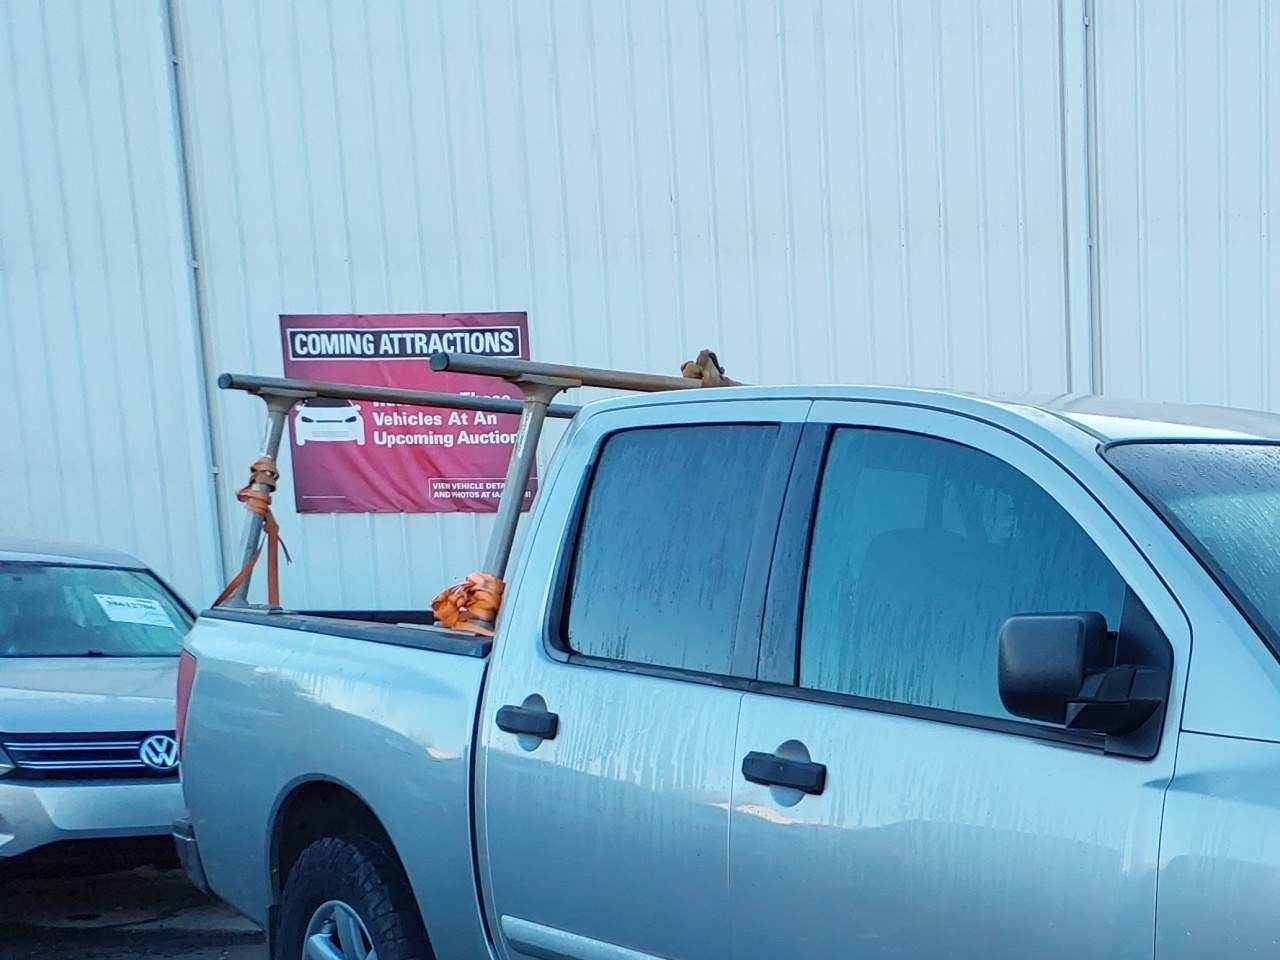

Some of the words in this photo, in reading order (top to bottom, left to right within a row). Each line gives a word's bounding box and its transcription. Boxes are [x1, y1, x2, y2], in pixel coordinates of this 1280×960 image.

[294, 333, 375, 355] COMING
[379, 331, 514, 355] ATTRACTIONS
[373, 413, 442, 426] Vehicles
[449, 412, 468, 425] At
[474, 412, 497, 425] An
[373, 432, 453, 447] Upcoming
[451, 482, 484, 490] VEHICLE
[142, 736, 178, 768] VW
